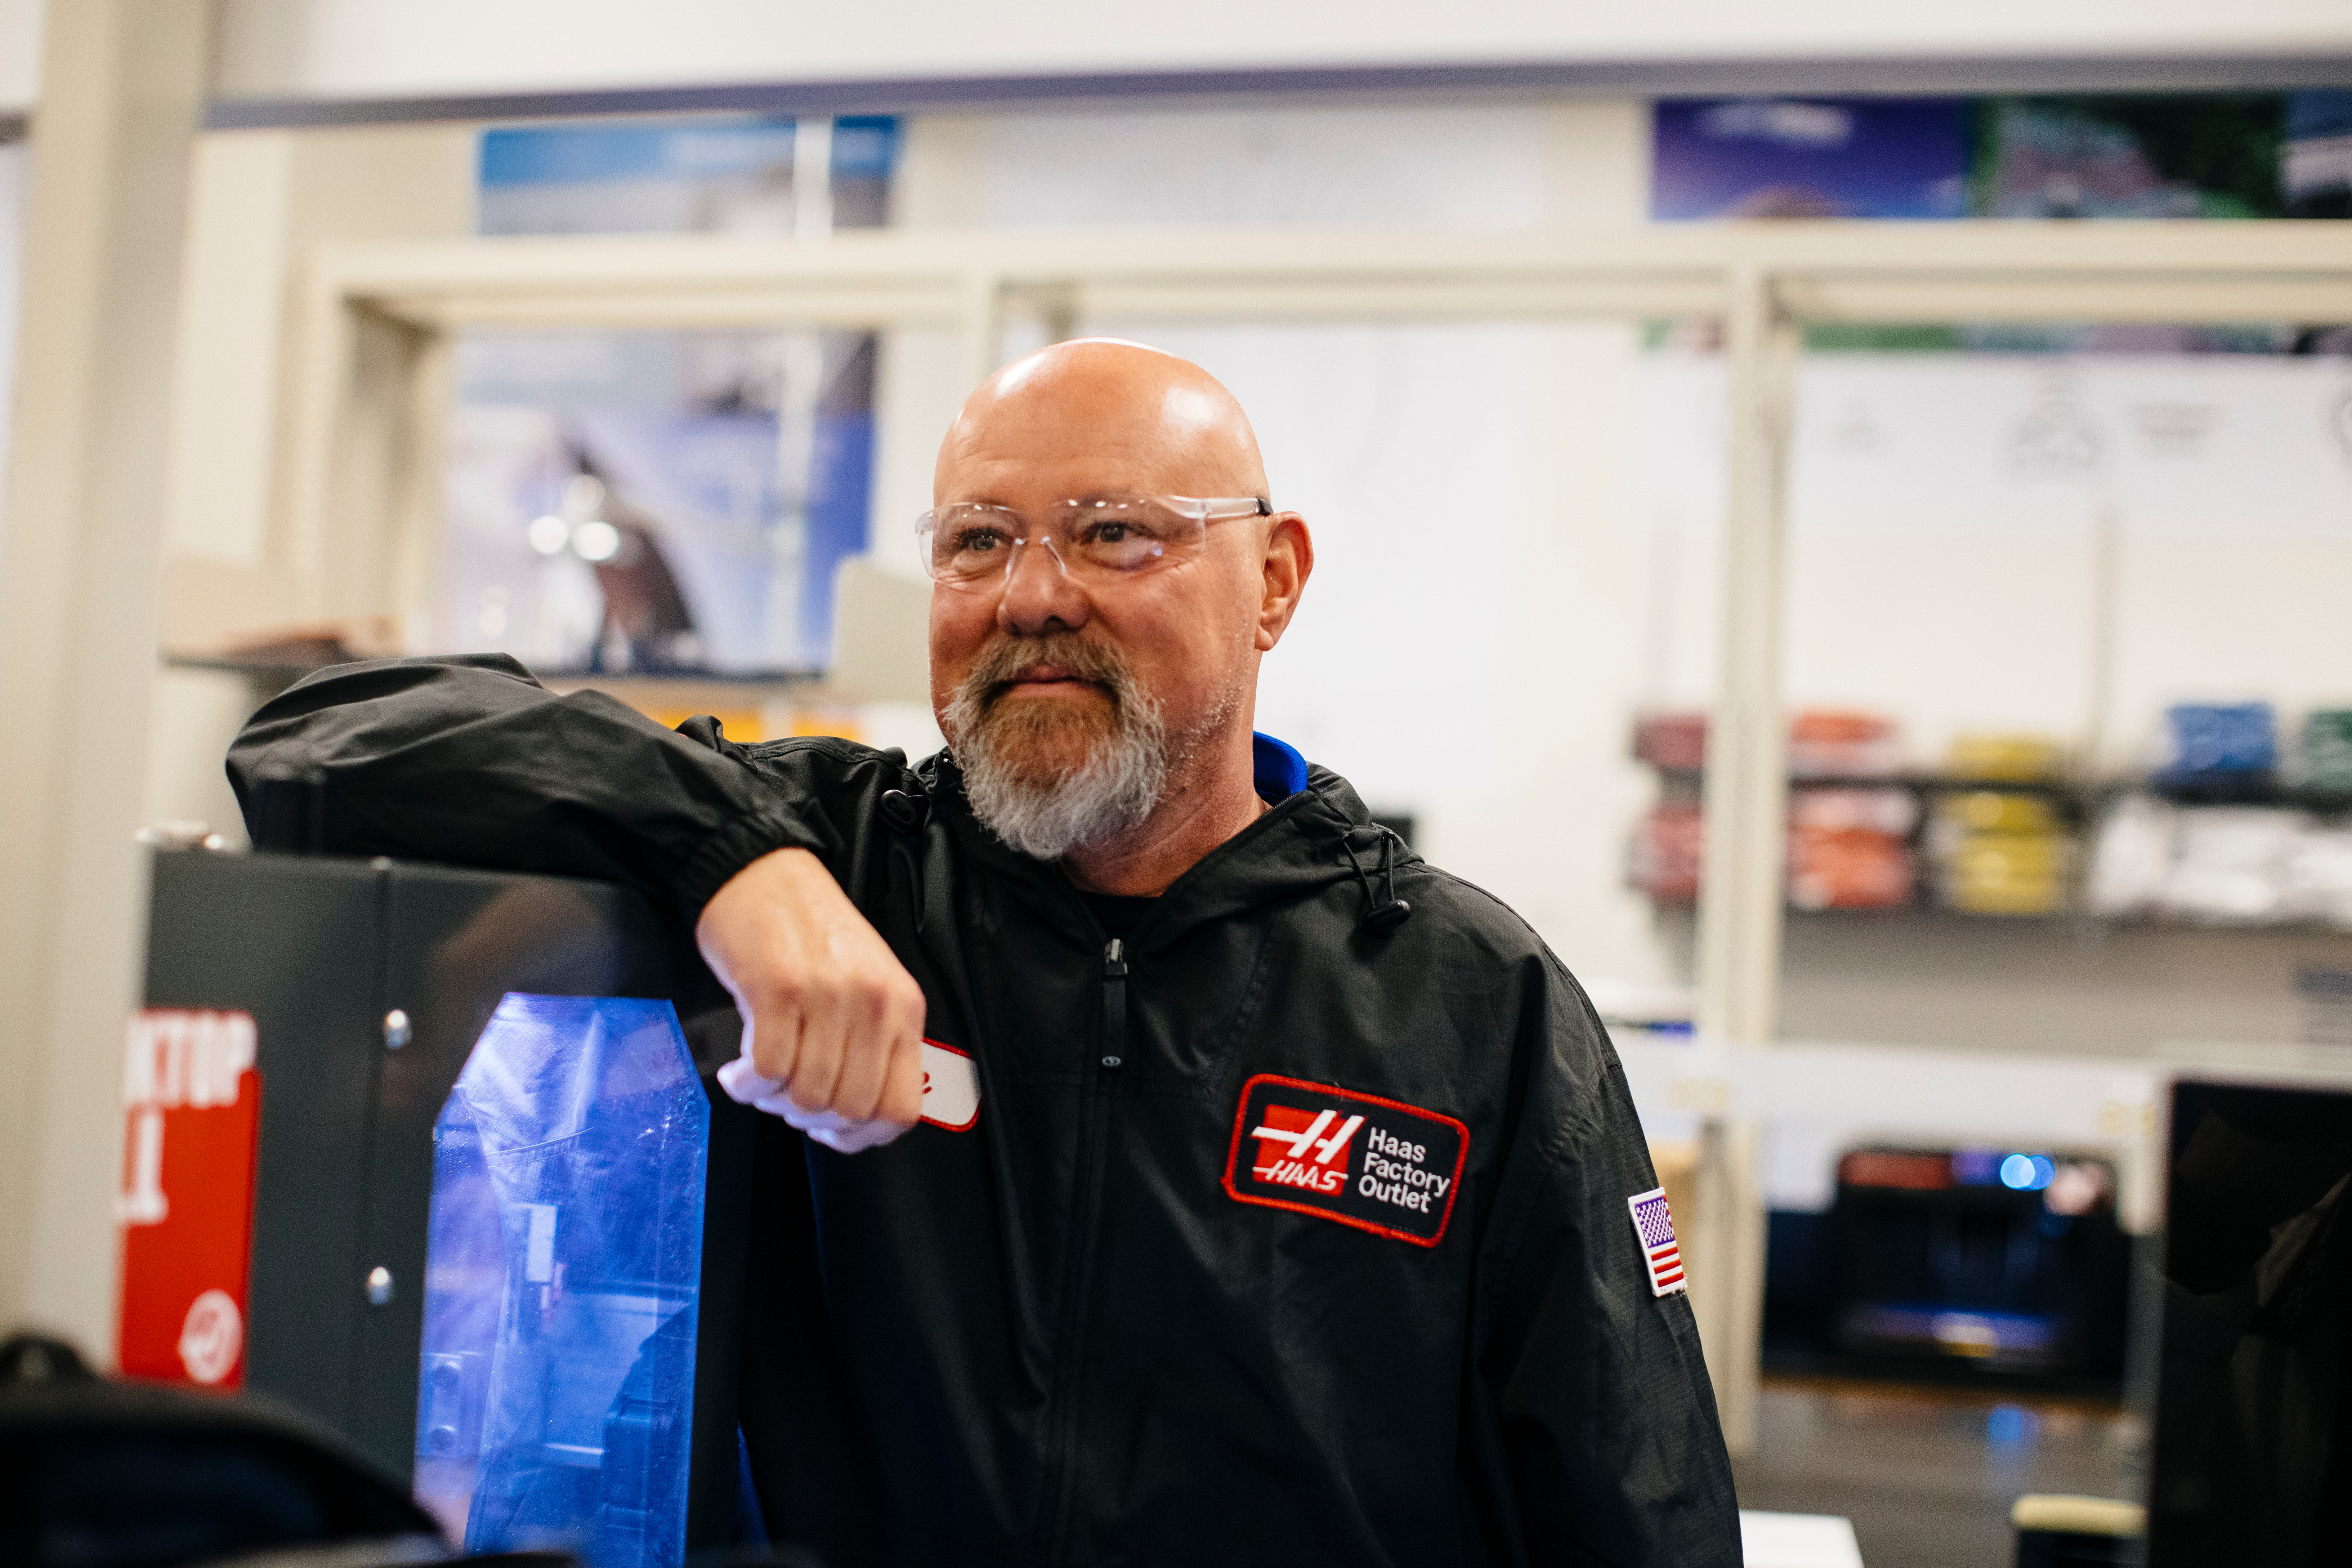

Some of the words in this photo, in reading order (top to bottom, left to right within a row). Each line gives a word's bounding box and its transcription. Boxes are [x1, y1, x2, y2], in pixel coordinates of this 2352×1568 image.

[1368, 1127, 1426, 1163] Haas
[1252, 1160, 1349, 1191] HAAS
[1363, 1152, 1450, 1198] Factory
[1358, 1175, 1429, 1213] Outlet
